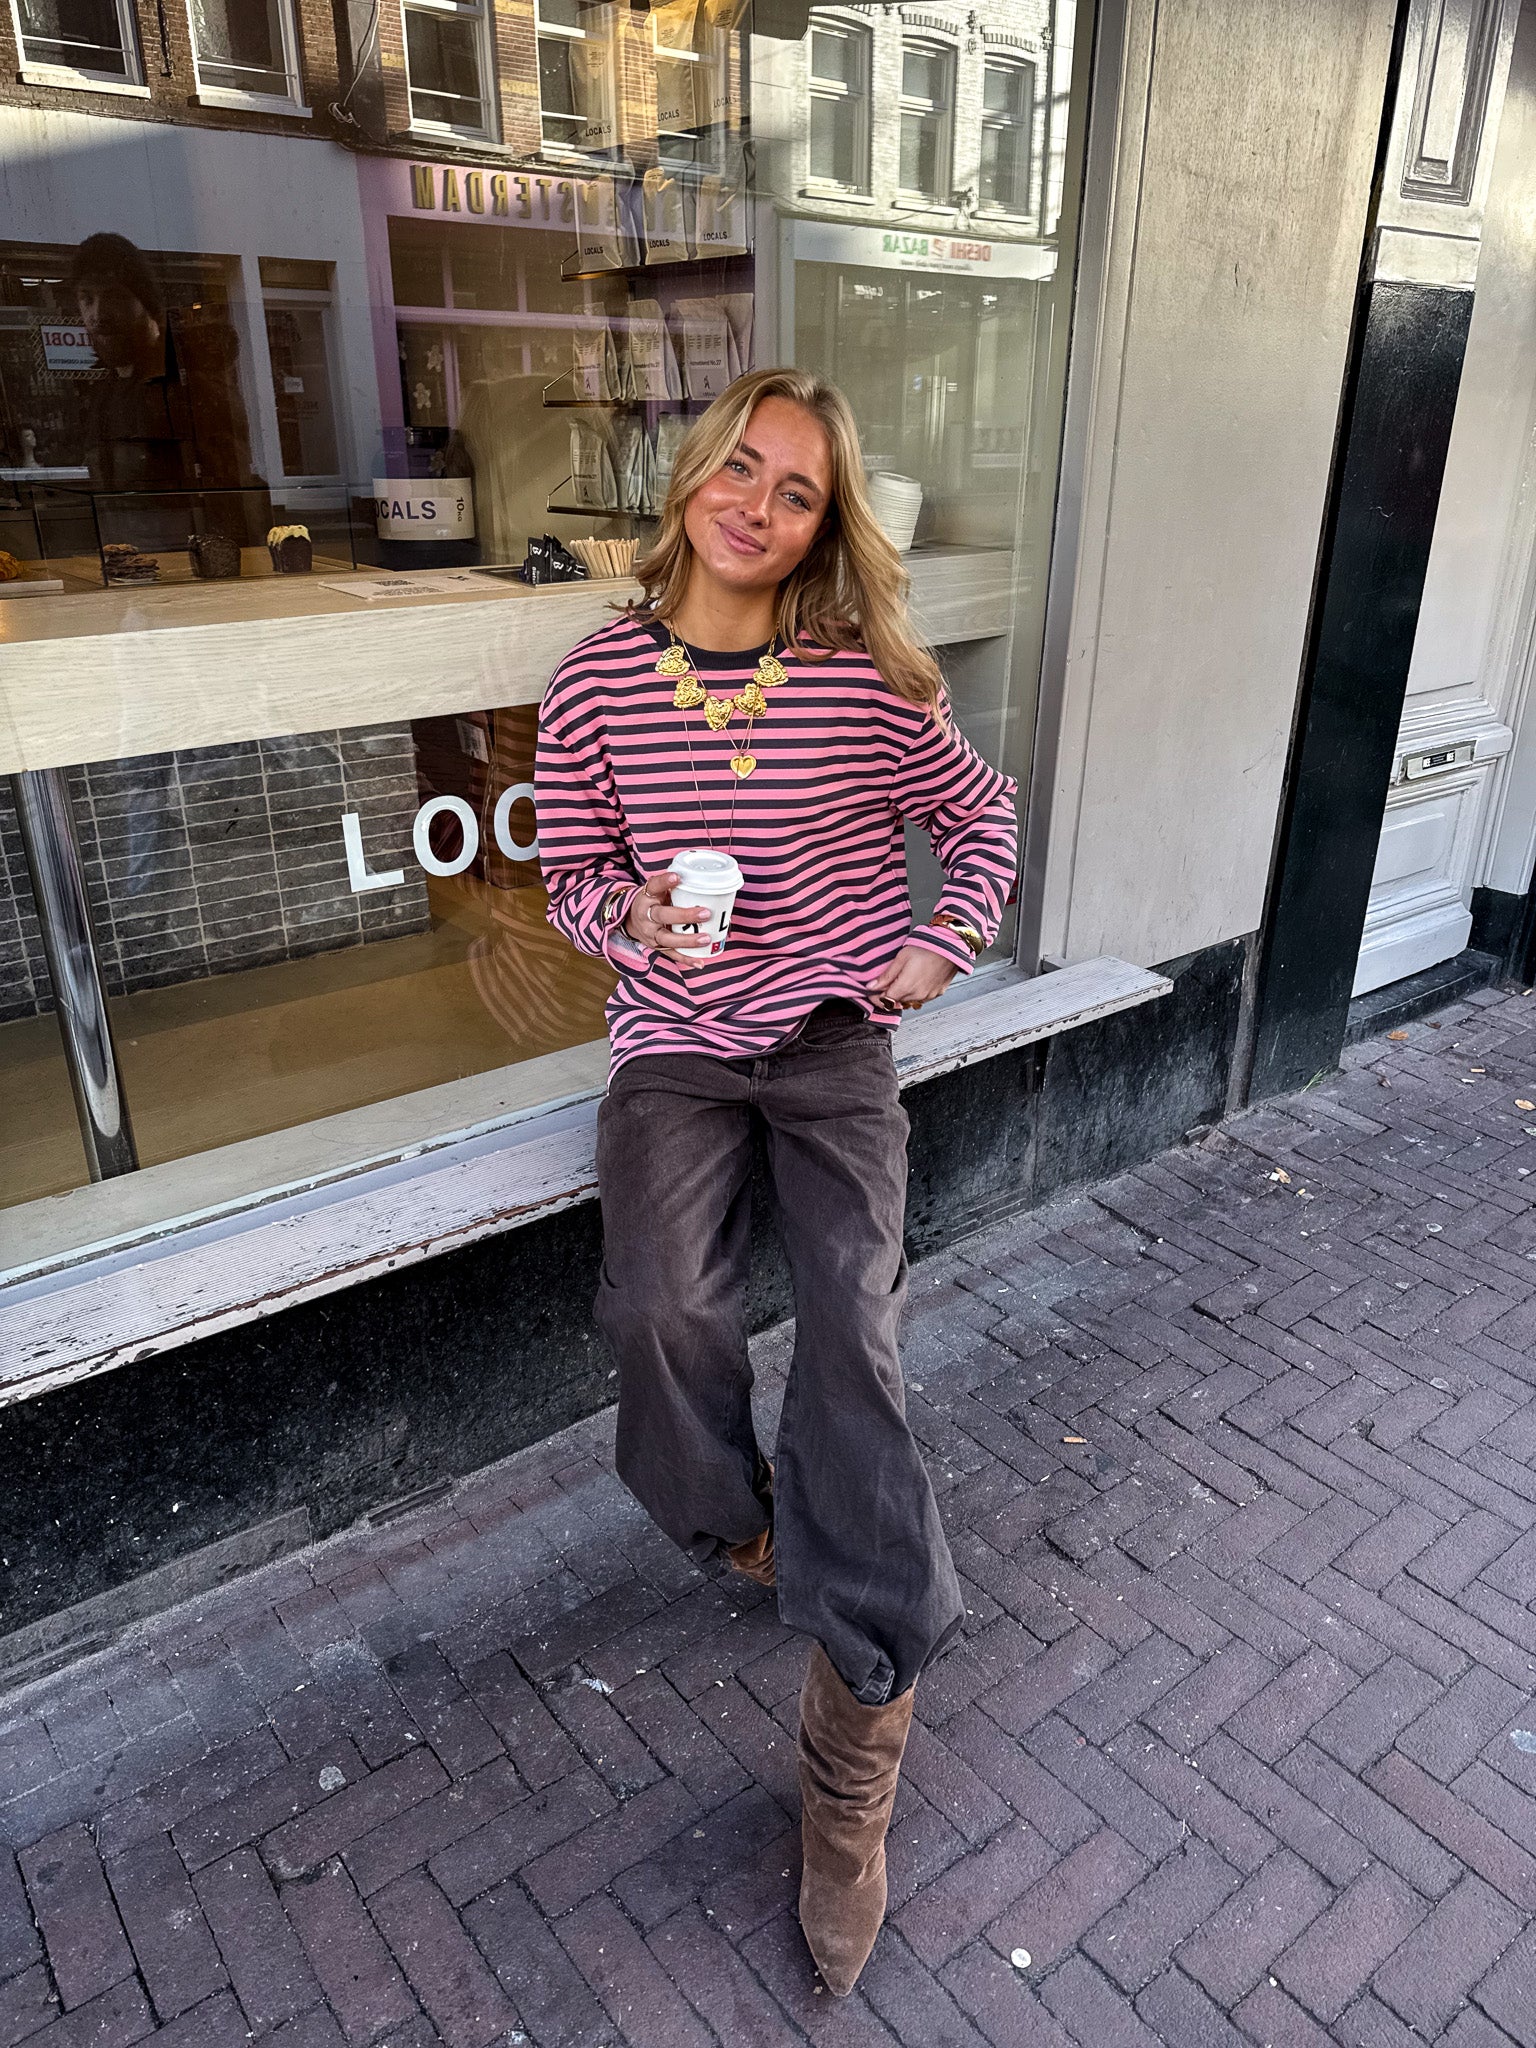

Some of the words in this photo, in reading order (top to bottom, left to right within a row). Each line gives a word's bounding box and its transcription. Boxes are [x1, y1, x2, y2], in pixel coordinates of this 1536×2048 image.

[658, 109, 680, 121] LOCALS
[585, 125, 612, 137] LOCALS
[703, 231, 728, 241] LOCALS
[650, 239, 670, 249] LOCALS
[584, 246, 604, 255] LOCALS
